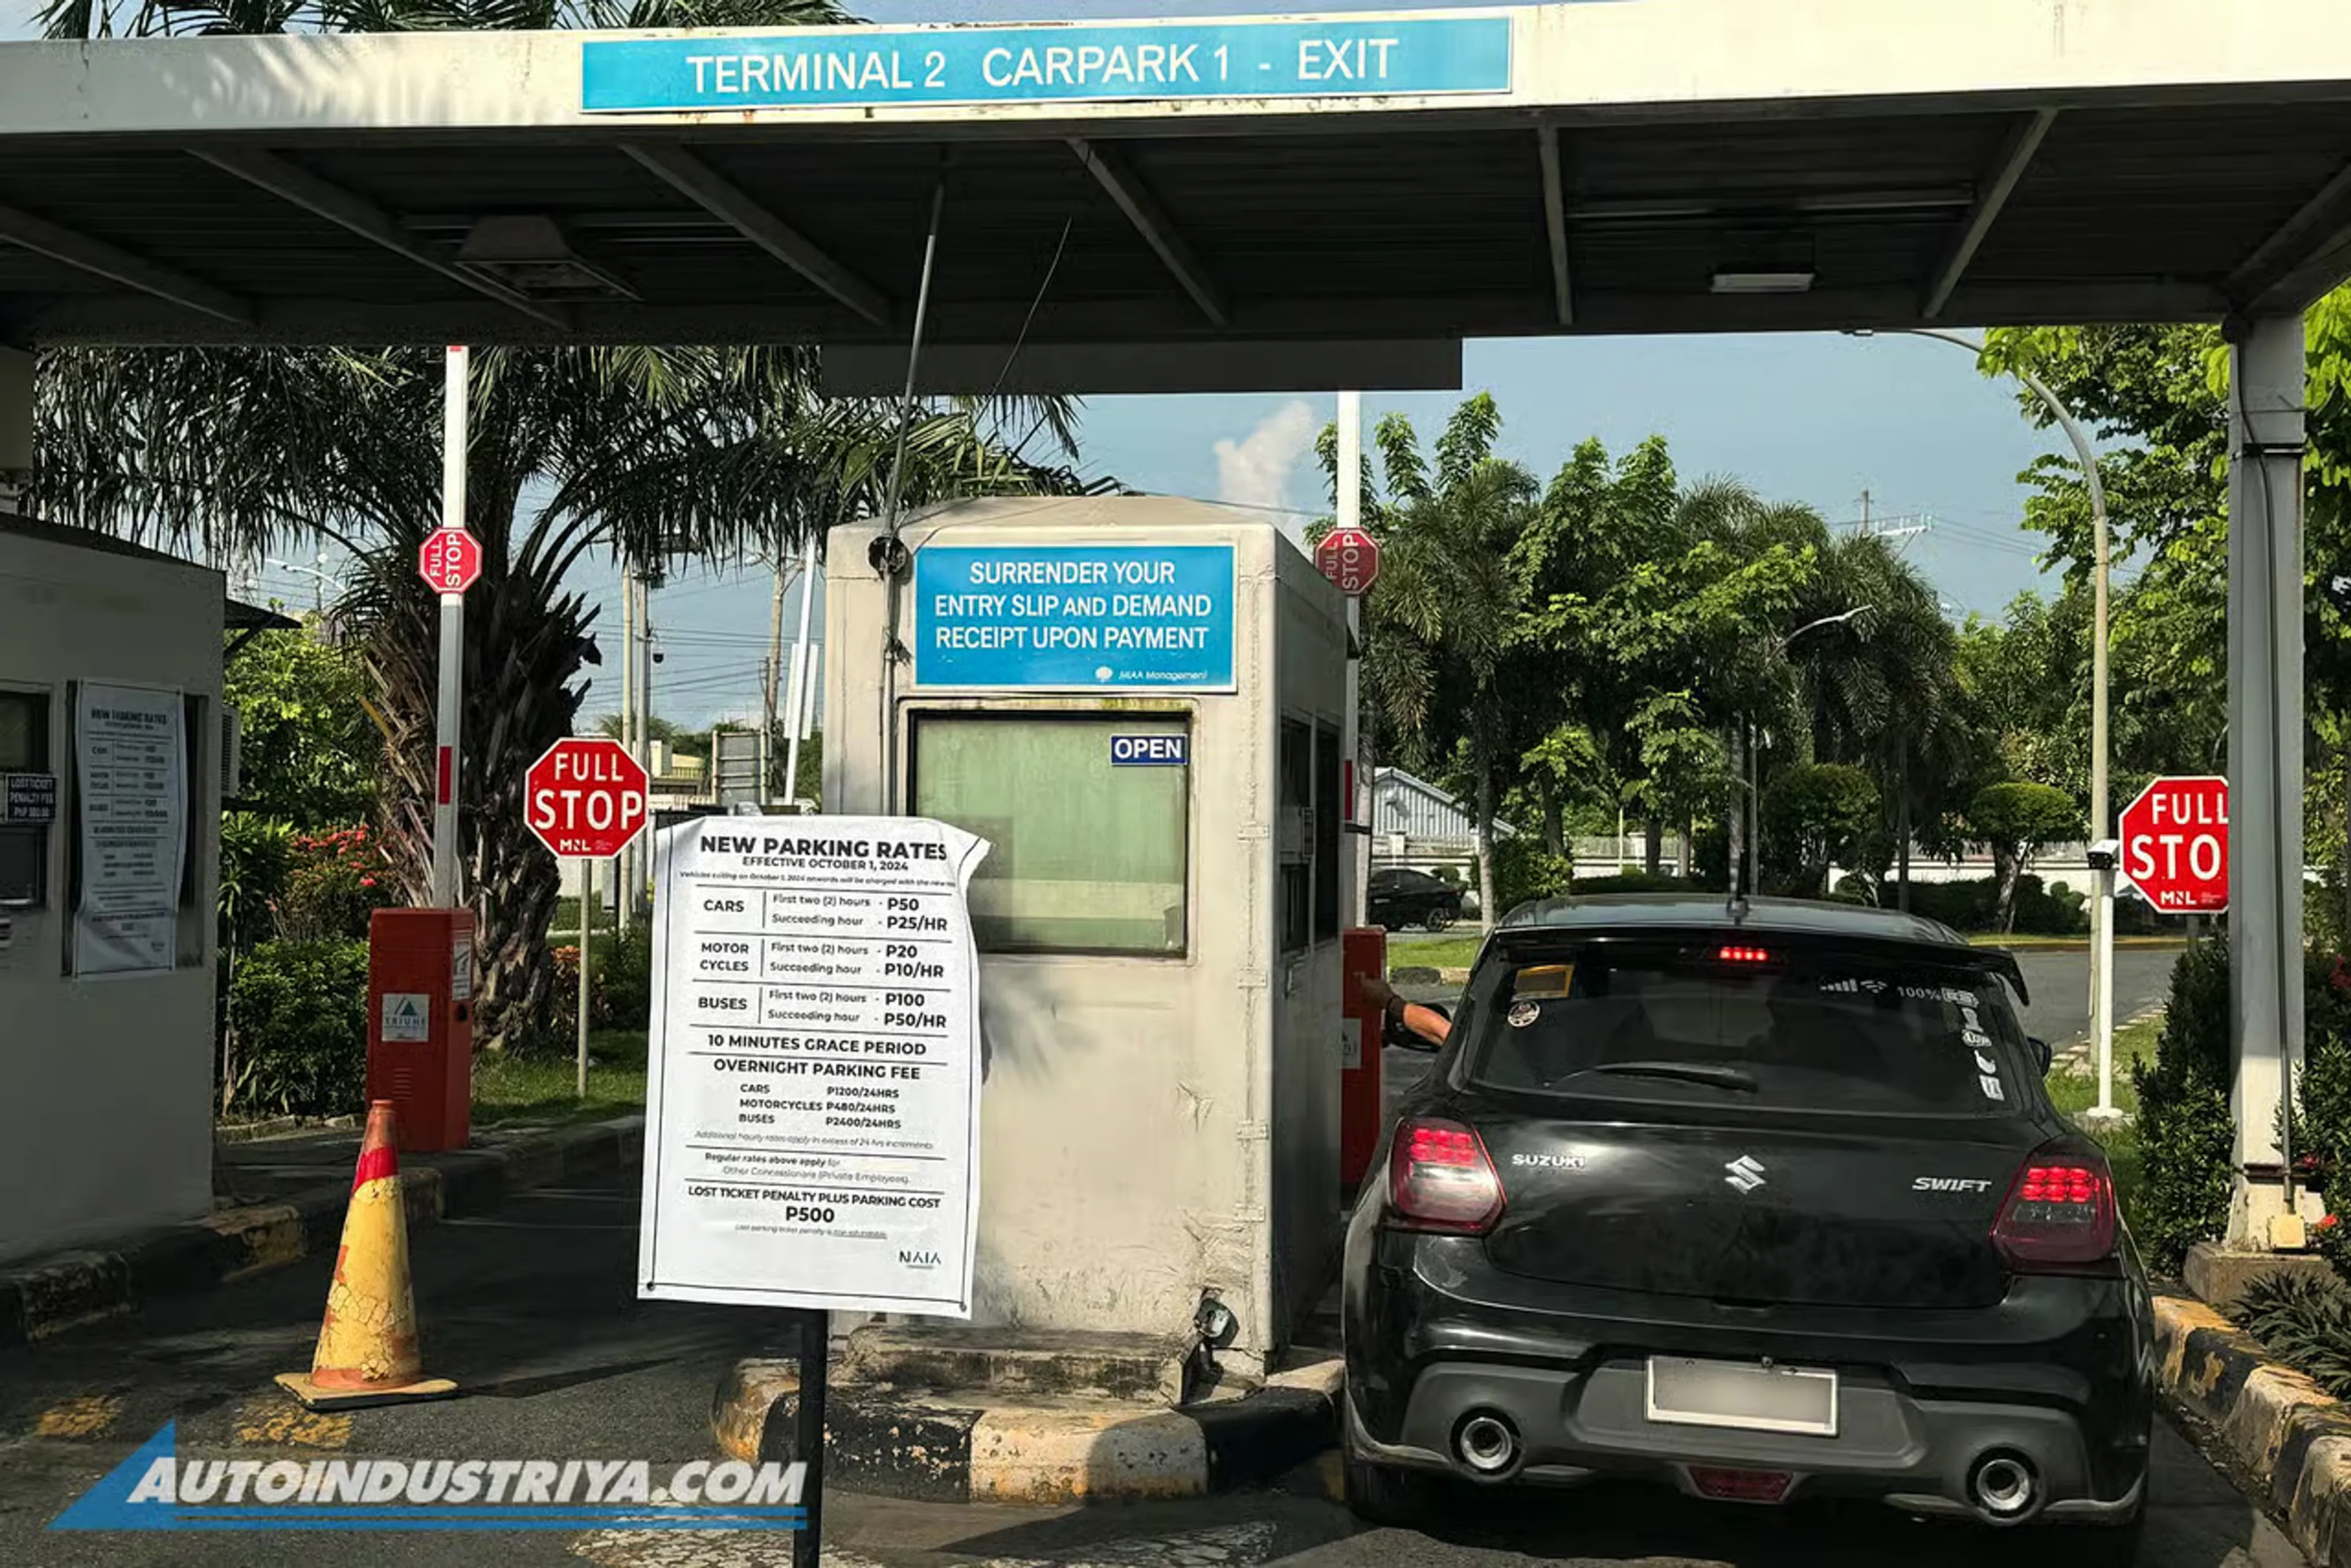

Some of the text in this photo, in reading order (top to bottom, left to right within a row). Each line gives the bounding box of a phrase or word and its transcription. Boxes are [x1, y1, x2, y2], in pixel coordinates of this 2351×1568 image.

[687, 50, 911, 94] TERMINAL
[923, 51, 946, 89] 2
[981, 43, 1201, 86] CARPARK
[1212, 44, 1228, 81] 1
[1297, 38, 1399, 81] EXIT
[430, 540, 442, 577] FULL
[446, 533, 462, 587] STOP
[1325, 541, 1338, 579] FULL
[1342, 535, 1359, 589] STOP
[970, 562, 1175, 584] SURRENDER YOUR
[935, 595, 1211, 617] ENTRY SLIP AND DEMAND
[936, 627, 1209, 648] RECEIPT UPON PAYMENT
[1114, 740, 1182, 759] OPEN
[555, 753, 624, 782] FULL
[534, 790, 642, 830] STOP
[2151, 793, 2229, 825] FULL
[700, 835, 947, 861] NEW PARKING RATES
[743, 857, 908, 872] EFFECTIVE OCTOBER 1, 2024
[2131, 834, 2221, 880] STO
[703, 900, 744, 913] CARS
[773, 895, 797, 905] First
[800, 897, 820, 906] two
[823, 896, 836, 909] (2)
[839, 897, 870, 907] hours
[887, 898, 919, 912] P50
[772, 914, 834, 928] Succeeding
[835, 915, 863, 927] hour
[887, 917, 947, 931] P25/HR
[701, 942, 749, 954] MOTOR
[771, 943, 796, 953] First
[799, 945, 819, 954] two
[821, 944, 834, 956] (2)
[836, 945, 869, 955] hours
[886, 945, 917, 958] P20
[700, 959, 749, 972] CYCLES
[770, 962, 833, 976] Succeeding
[833, 963, 861, 975] hour
[885, 964, 944, 978] P10/HR
[769, 990, 793, 1000] First
[796, 992, 816, 1002] two
[819, 992, 833, 1004] (2)
[834, 992, 866, 1003] hours
[885, 993, 924, 1007] P100
[1898, 986, 1941, 1000] 100%
[698, 997, 747, 1010] BUSES
[768, 1008, 831, 1023] Succeeding
[833, 1010, 860, 1022] hour
[884, 1013, 947, 1029] P50/HR
[708, 1035, 926, 1055] 10 MINUTES GRACE PERIOD
[714, 1059, 920, 1080] OVERNIGHT PARKING FEE
[740, 1084, 899, 1098] CARS P1200/24HRS
[740, 1100, 895, 1114] MOTORCYCLES P480/24HRS
[739, 1114, 901, 1129] BUSES P2400/24HRS
[695, 1131, 737, 1140] Additional
[705, 1152, 741, 1163] Regular
[769, 1156, 797, 1165] above
[800, 1158, 825, 1168] apply
[1512, 1153, 1586, 1168] SUZUKI
[723, 1165, 749, 1176] Other
[1911, 1176, 1992, 1193] SWIFT
[689, 1187, 941, 1208] LOST TICKET PENALTY PLUS PARKING COST
[786, 1206, 835, 1223] P500
